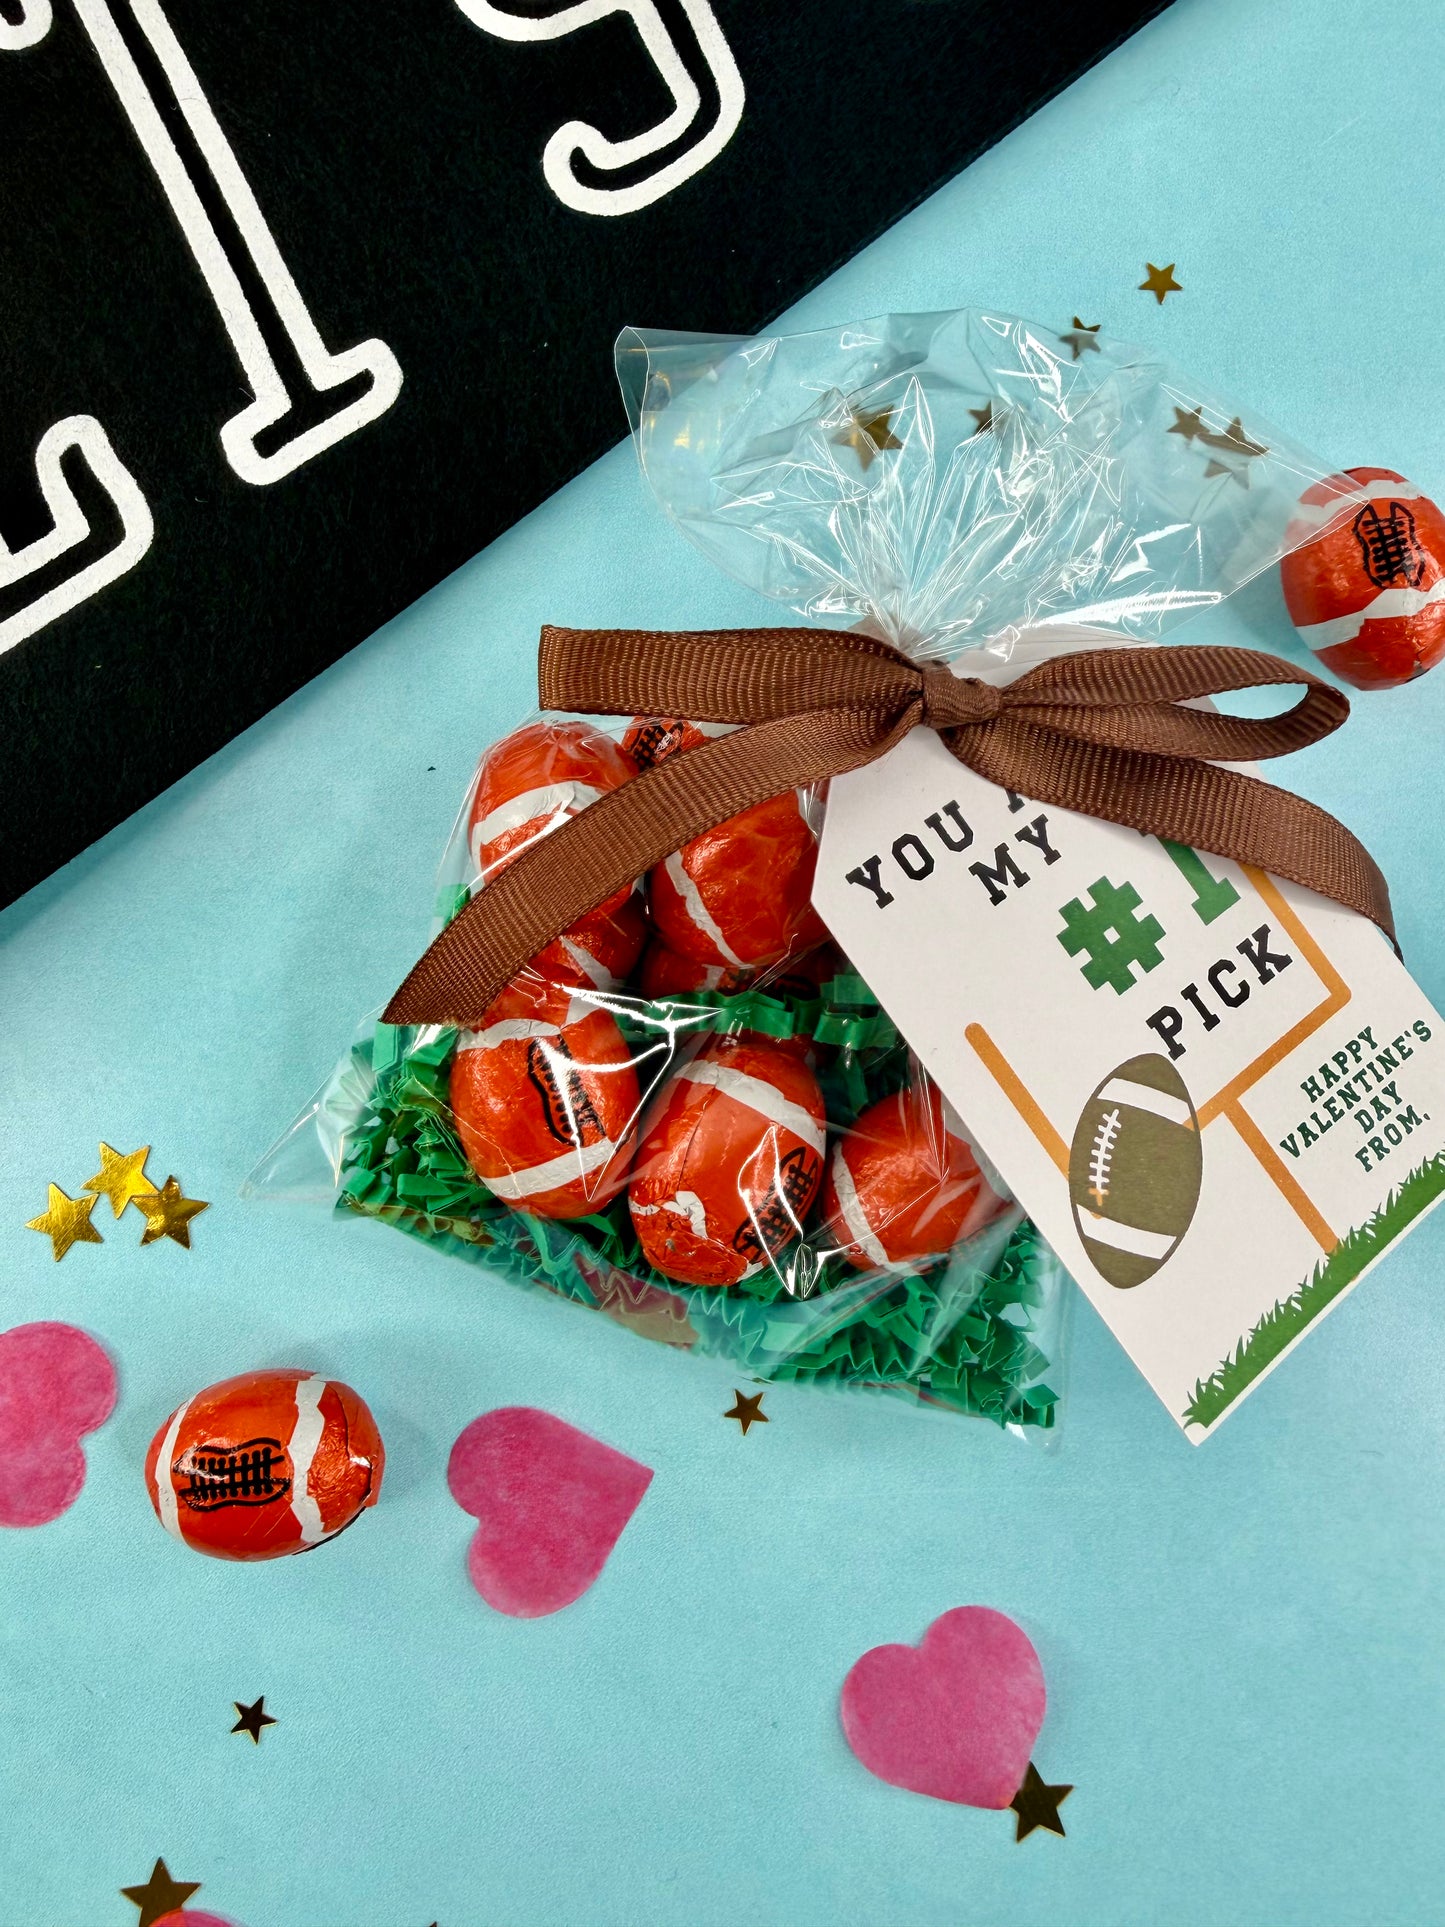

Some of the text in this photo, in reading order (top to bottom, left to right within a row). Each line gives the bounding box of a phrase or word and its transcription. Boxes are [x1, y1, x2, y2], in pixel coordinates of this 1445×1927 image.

[845, 799, 974, 909] YOU
[968, 813, 1062, 906] MY
[1056, 832, 1242, 996] #1
[1145, 923, 1294, 1062] PICK
[1279, 1020, 1432, 1158] VALENTINE'S
[1300, 1025, 1378, 1103] HAPPY
[1354, 1080, 1403, 1134] DAY
[1355, 1104, 1431, 1173] FROM,
